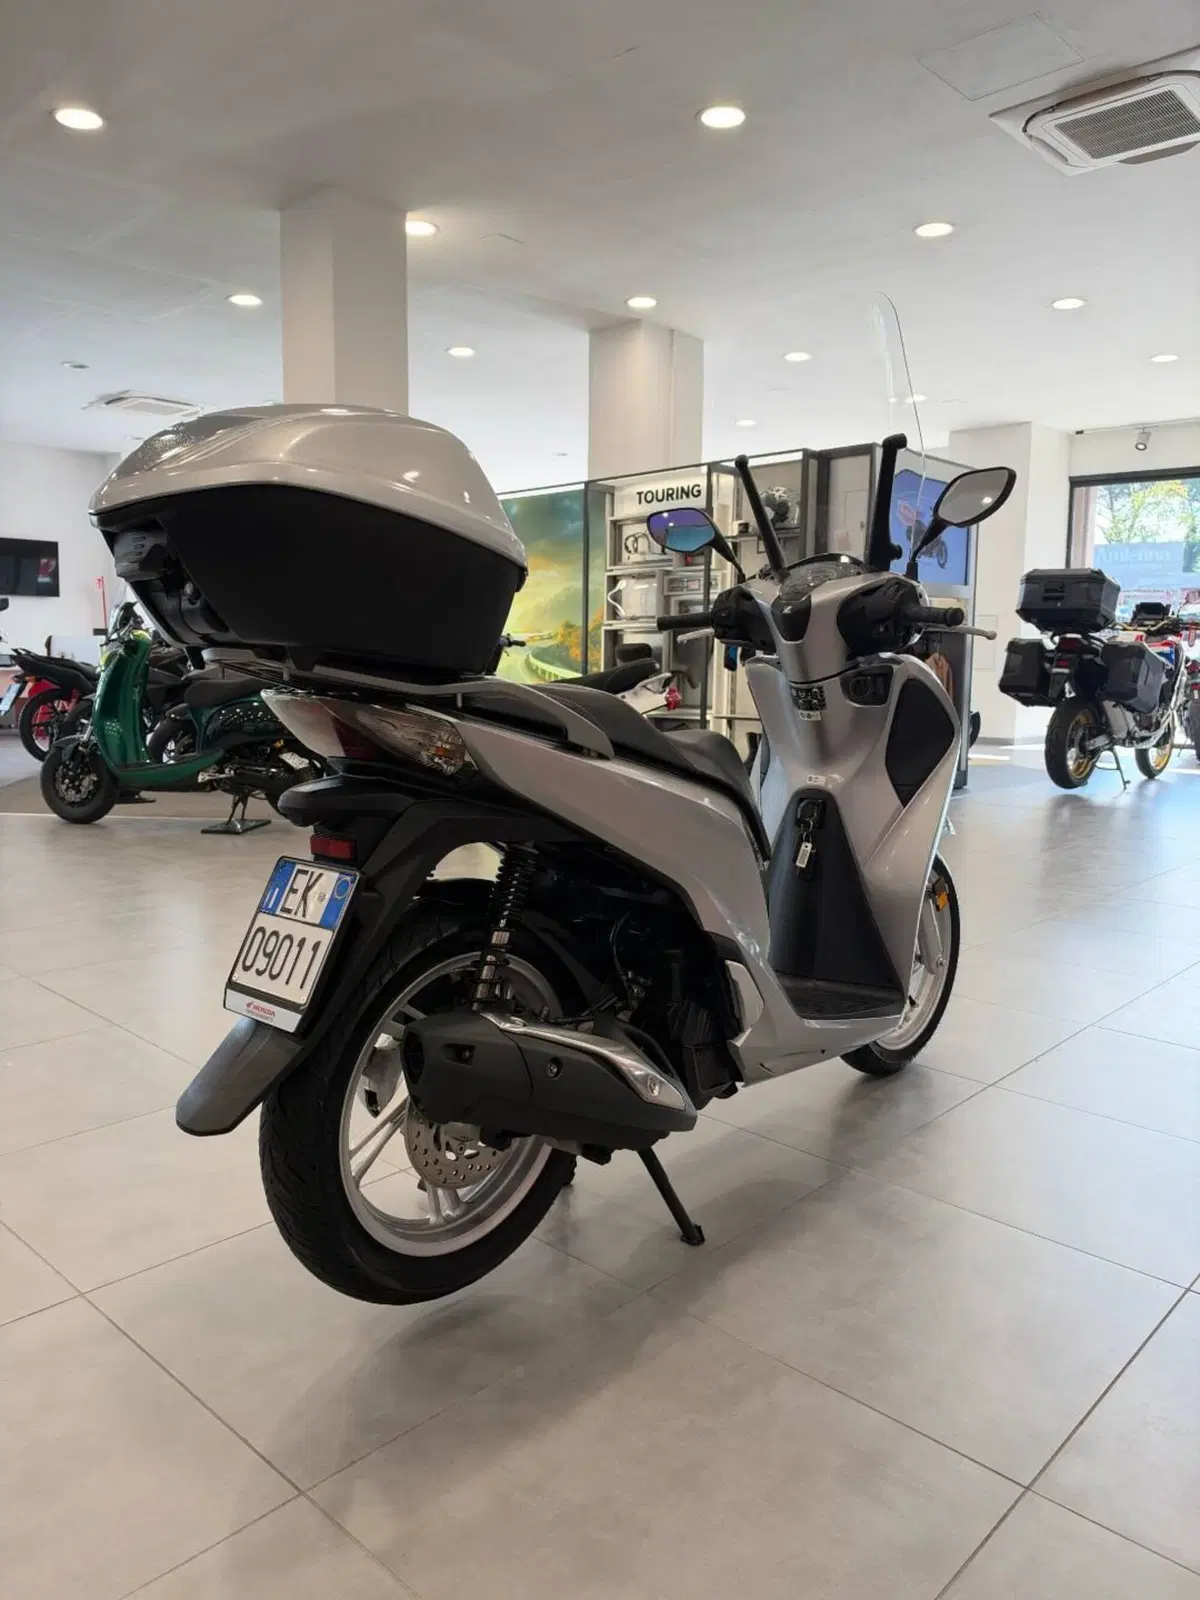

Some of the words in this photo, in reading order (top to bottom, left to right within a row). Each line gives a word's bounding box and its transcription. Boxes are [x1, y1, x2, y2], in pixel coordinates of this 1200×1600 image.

[636, 484, 702, 505] TOURING
[280, 868, 324, 918] EK
[241, 926, 322, 990] 09011
